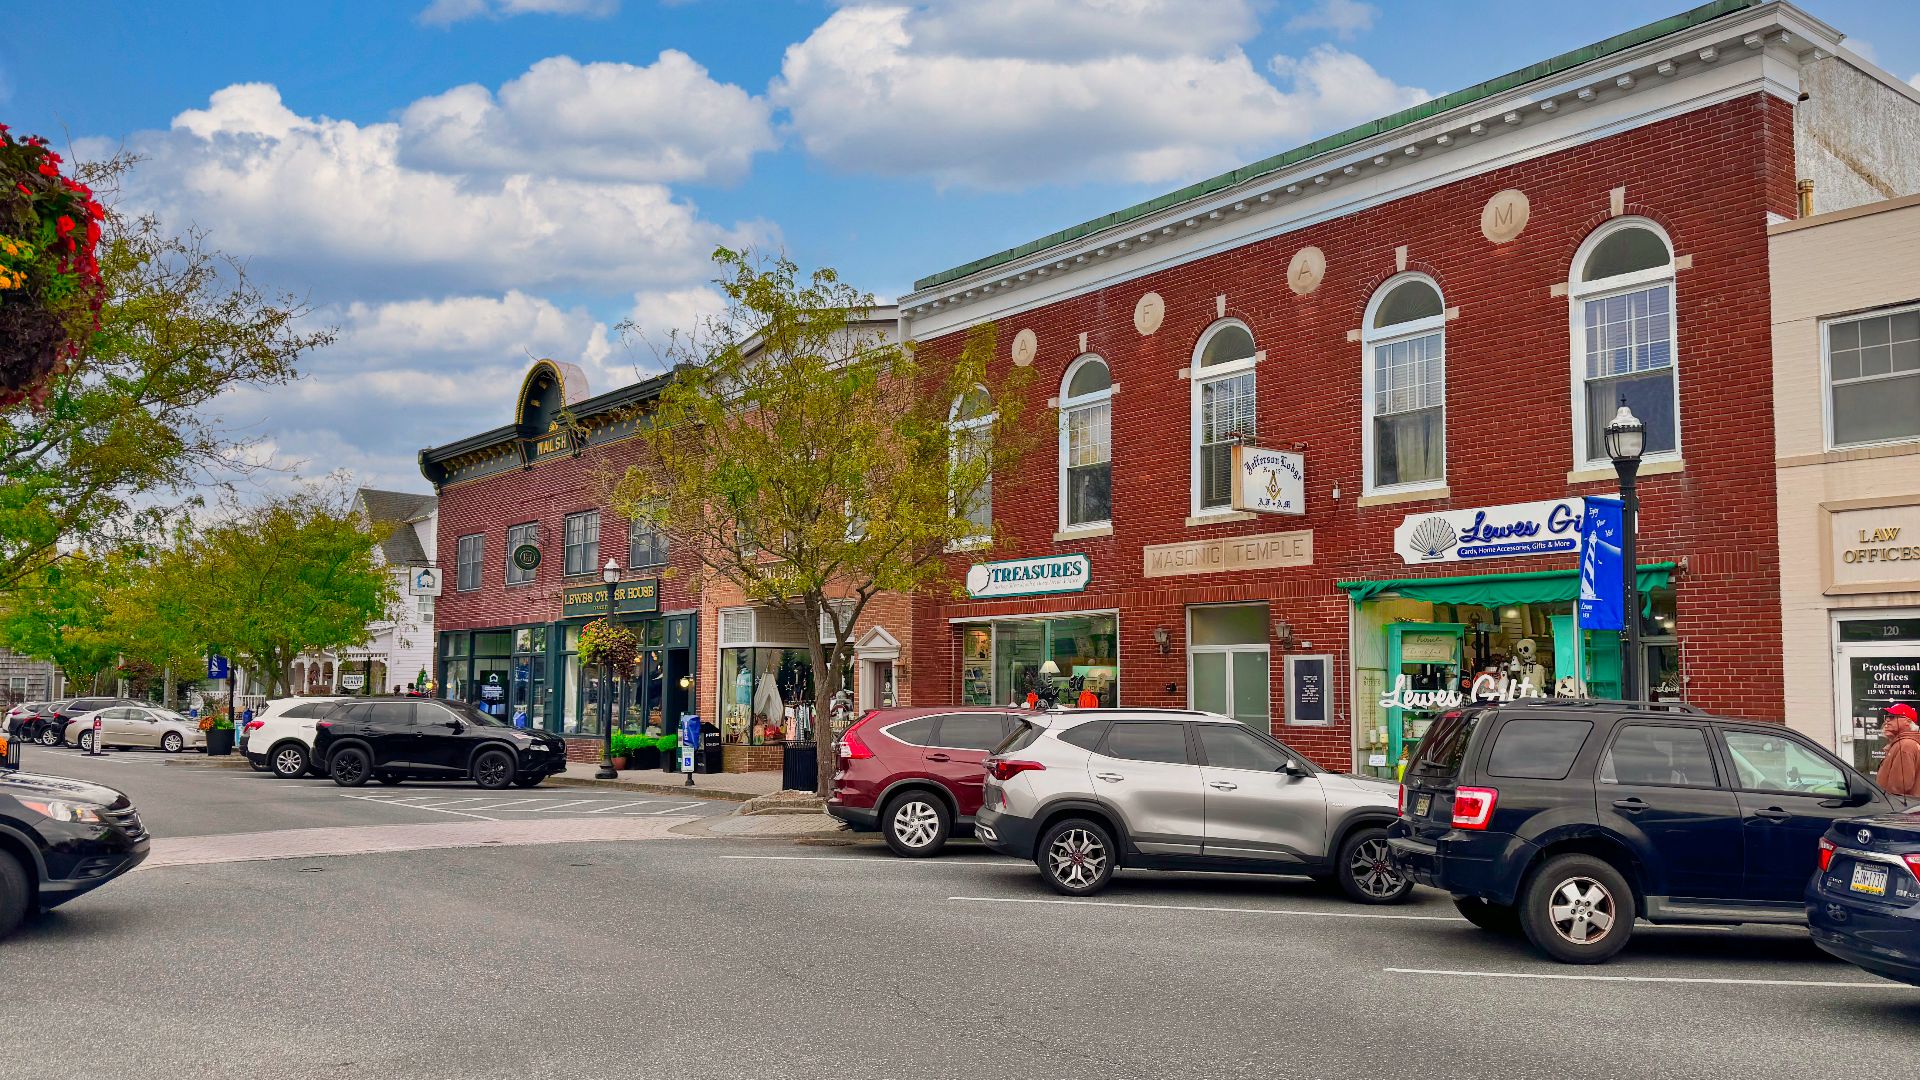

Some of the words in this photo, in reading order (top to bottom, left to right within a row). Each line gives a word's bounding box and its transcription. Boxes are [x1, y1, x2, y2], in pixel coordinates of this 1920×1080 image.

[1493, 202, 1514, 228] M
[1297, 259, 1313, 281] A
[1142, 303, 1153, 322] F
[1018, 339, 1028, 357] A
[537, 435, 567, 455] WALSH
[1280, 456, 1302, 481] Lodge
[1459, 511, 1540, 543] Lewes
[1548, 503, 1583, 534] Gi
[1859, 527, 1900, 543] LAW
[1152, 547, 1220, 569] MASONIC
[1233, 539, 1304, 562] TEMPLE
[1460, 547, 1477, 555] Cards,
[1479, 546, 1496, 554] Home
[1532, 542, 1546, 550] Gifts
[1843, 546, 1920, 564] OFFICES
[992, 561, 1082, 582] TREASURES
[564, 592, 592, 605] LEWES
[595, 588, 626, 602] OYER
[628, 586, 654, 599] HOUSE
[1883, 626, 1899, 636] 120
[1862, 662, 1920, 672] Professional
[1874, 672, 1909, 681] Offices
[1379, 674, 1462, 710] Lewes
